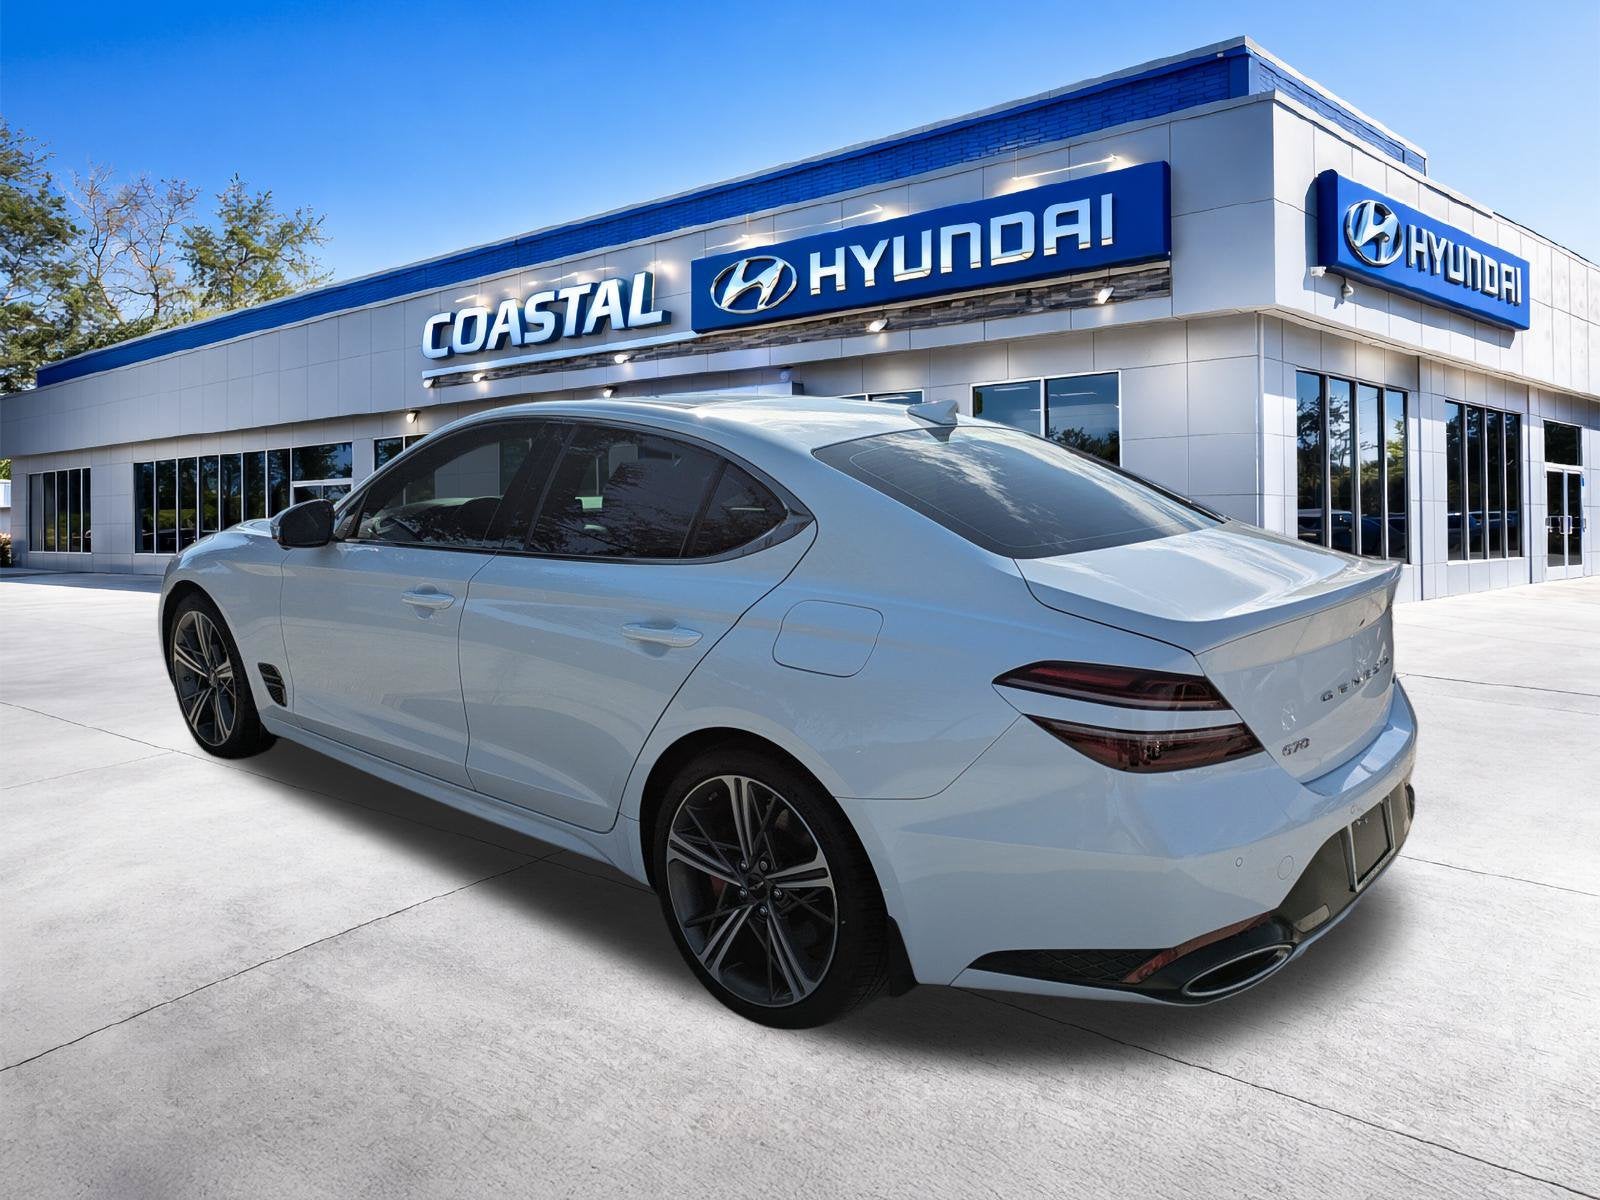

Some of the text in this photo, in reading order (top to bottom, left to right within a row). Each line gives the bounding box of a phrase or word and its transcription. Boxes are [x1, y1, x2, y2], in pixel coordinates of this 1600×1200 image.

[810, 193, 1113, 295] HYUNDAI
[1406, 224, 1521, 306] HYUNDAI
[422, 271, 671, 359] COASTAL
[1282, 737, 1310, 756] G70
